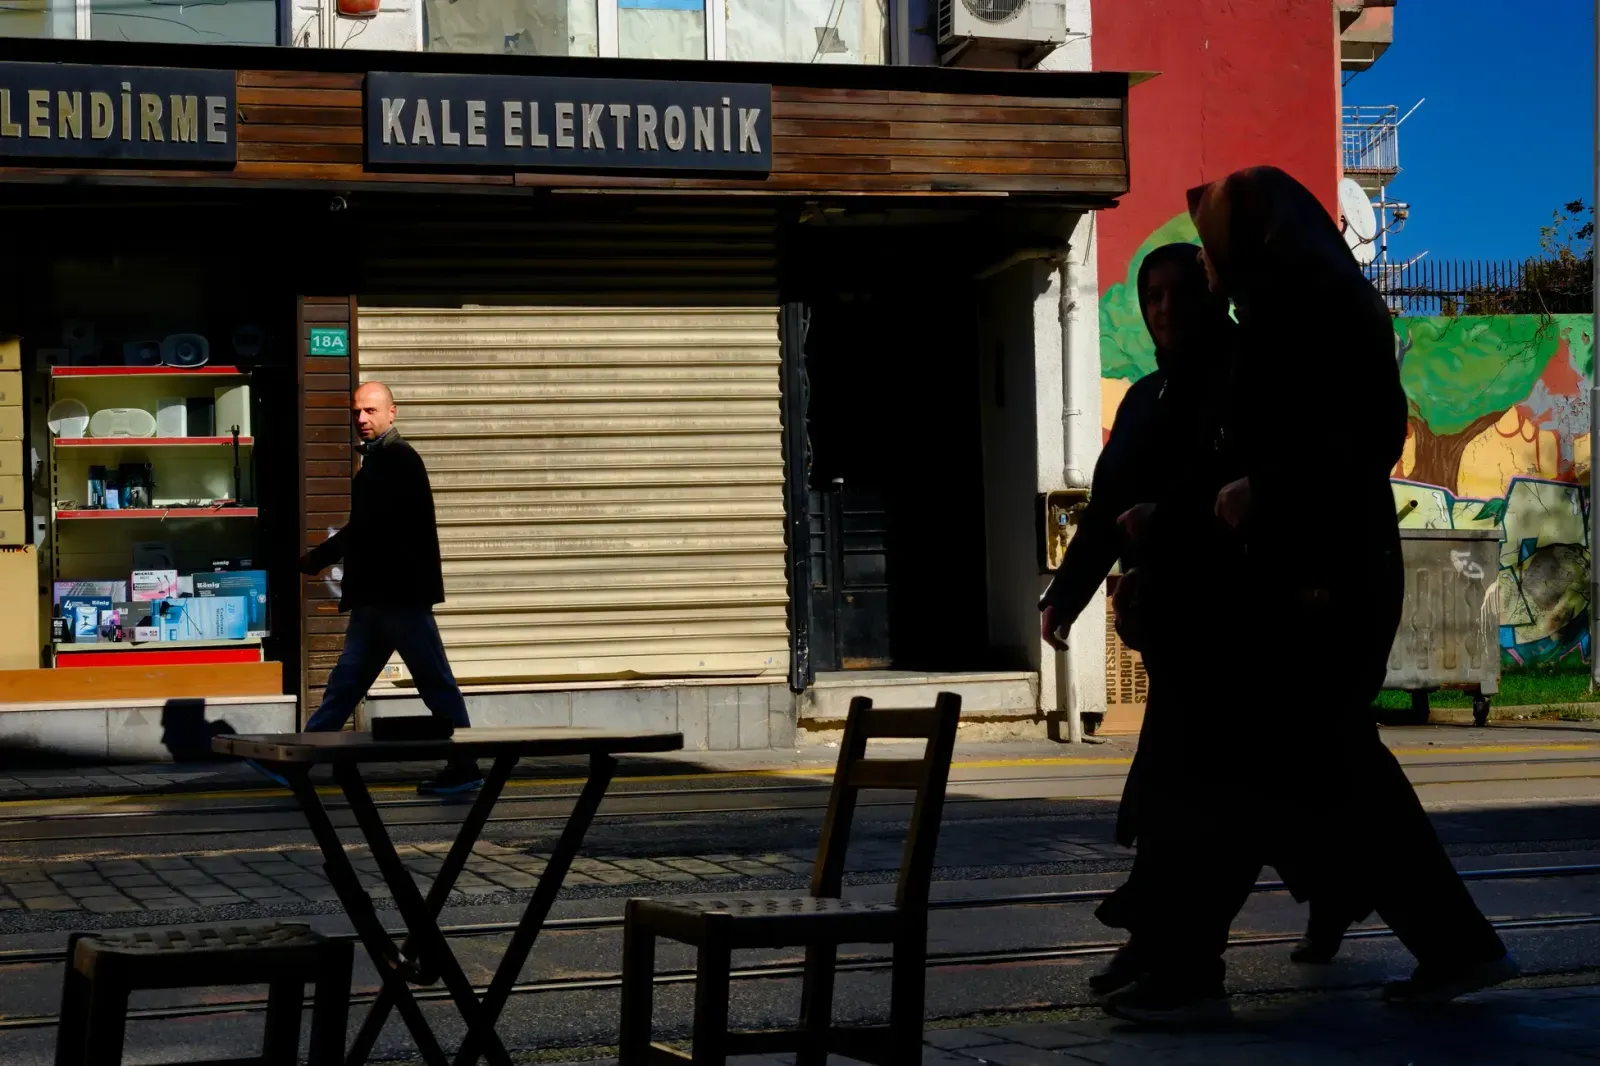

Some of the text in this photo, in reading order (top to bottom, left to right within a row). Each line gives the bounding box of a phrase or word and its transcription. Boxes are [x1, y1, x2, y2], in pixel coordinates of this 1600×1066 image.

[381, 97, 762, 154] KALE ELEKTRONİK
[312, 335, 344, 347] 18A
